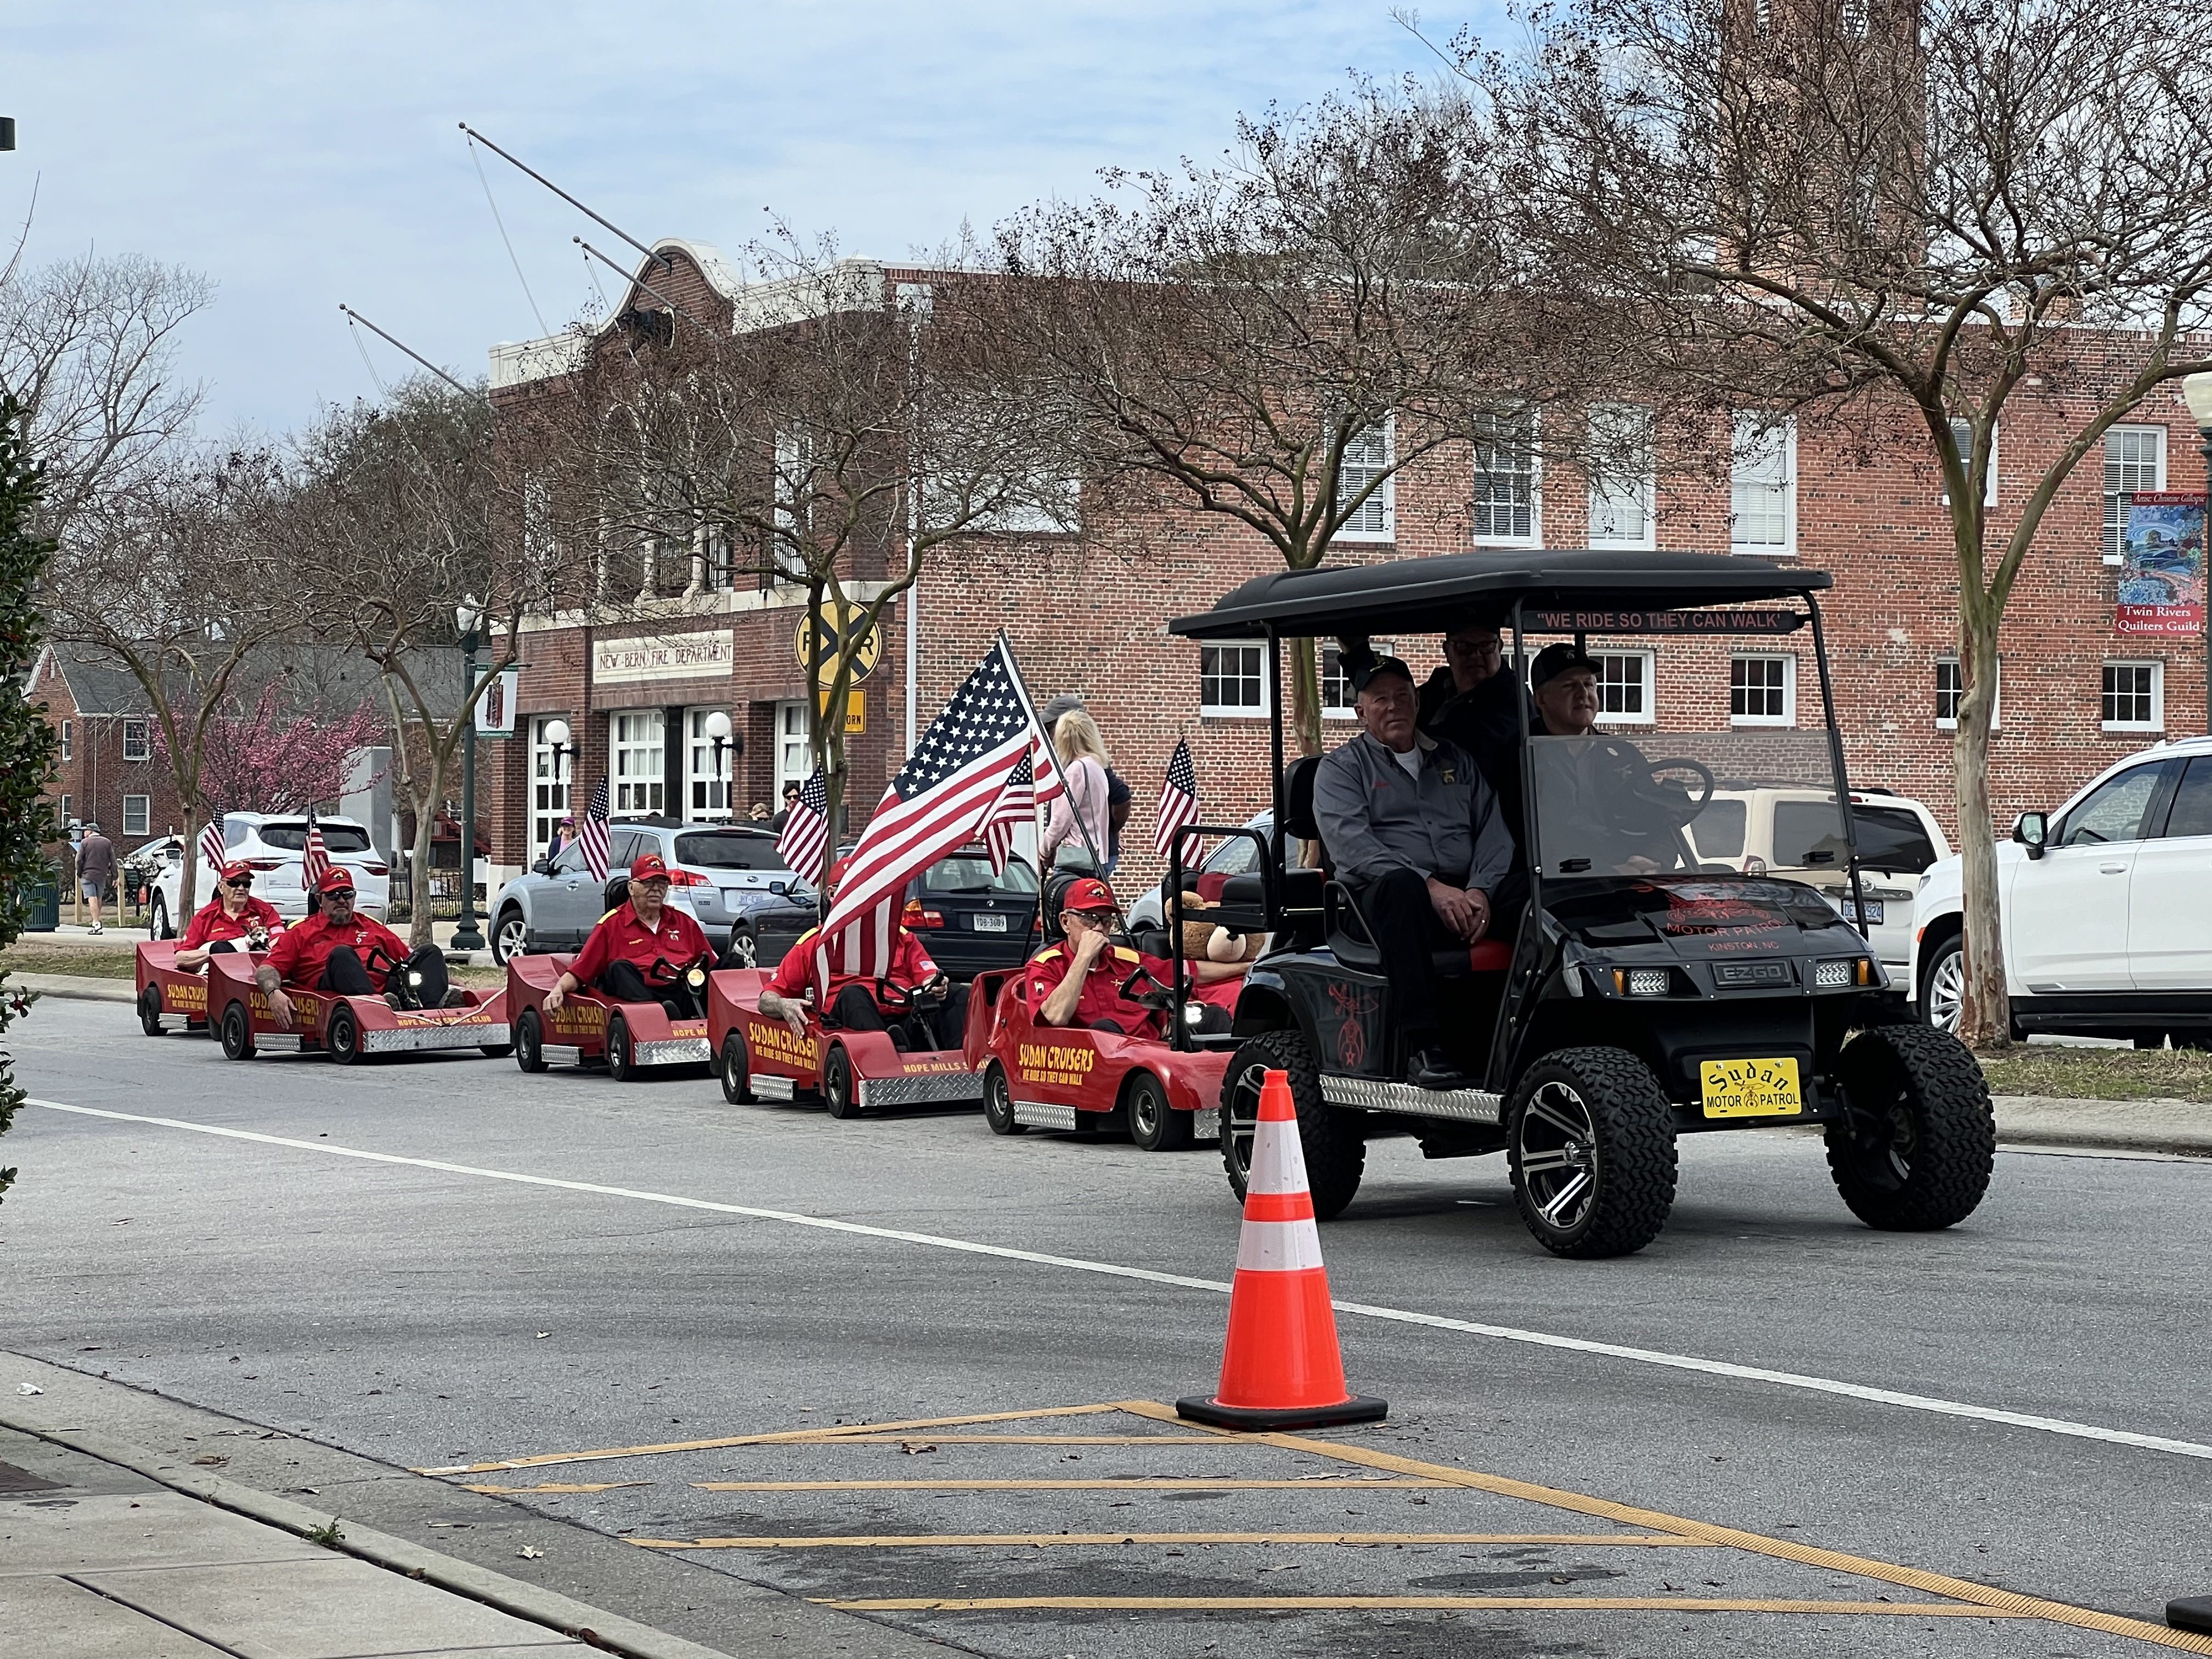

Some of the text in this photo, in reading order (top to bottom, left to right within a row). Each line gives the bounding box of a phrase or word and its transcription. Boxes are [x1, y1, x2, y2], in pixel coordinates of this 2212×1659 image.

[2124, 606, 2191, 617] Twin Rivers
[1577, 613, 1615, 628] RIDE
[1620, 613, 1642, 628] SO
[1647, 613, 1688, 628] THEY
[1692, 613, 1726, 628] CAN
[2118, 620, 2200, 633] Quilters Guild
[600, 645, 732, 669] NEW BERN FIRE DEPARTMENT
[847, 714, 861, 725] ORN
[1666, 918, 1787, 936] MOTOR PATROL
[1763, 941, 1780, 950] NC
[168, 984, 187, 999] SUDAN
[749, 1022, 780, 1048] SUDAN
[755, 1045, 816, 1071] WE RIDE SO THEY CAN WALK
[1019, 1043, 1094, 1073] SUDAN CRUISERS
[903, 1064, 929, 1073] HOPE
[930, 1062, 961, 1071] MILLS
[1023, 1069, 1083, 1086] WE RIDE SO THEY CAN WALK
[1709, 1062, 1788, 1093] Sudan
[1707, 1093, 1799, 1108] MOTOR PATROL
